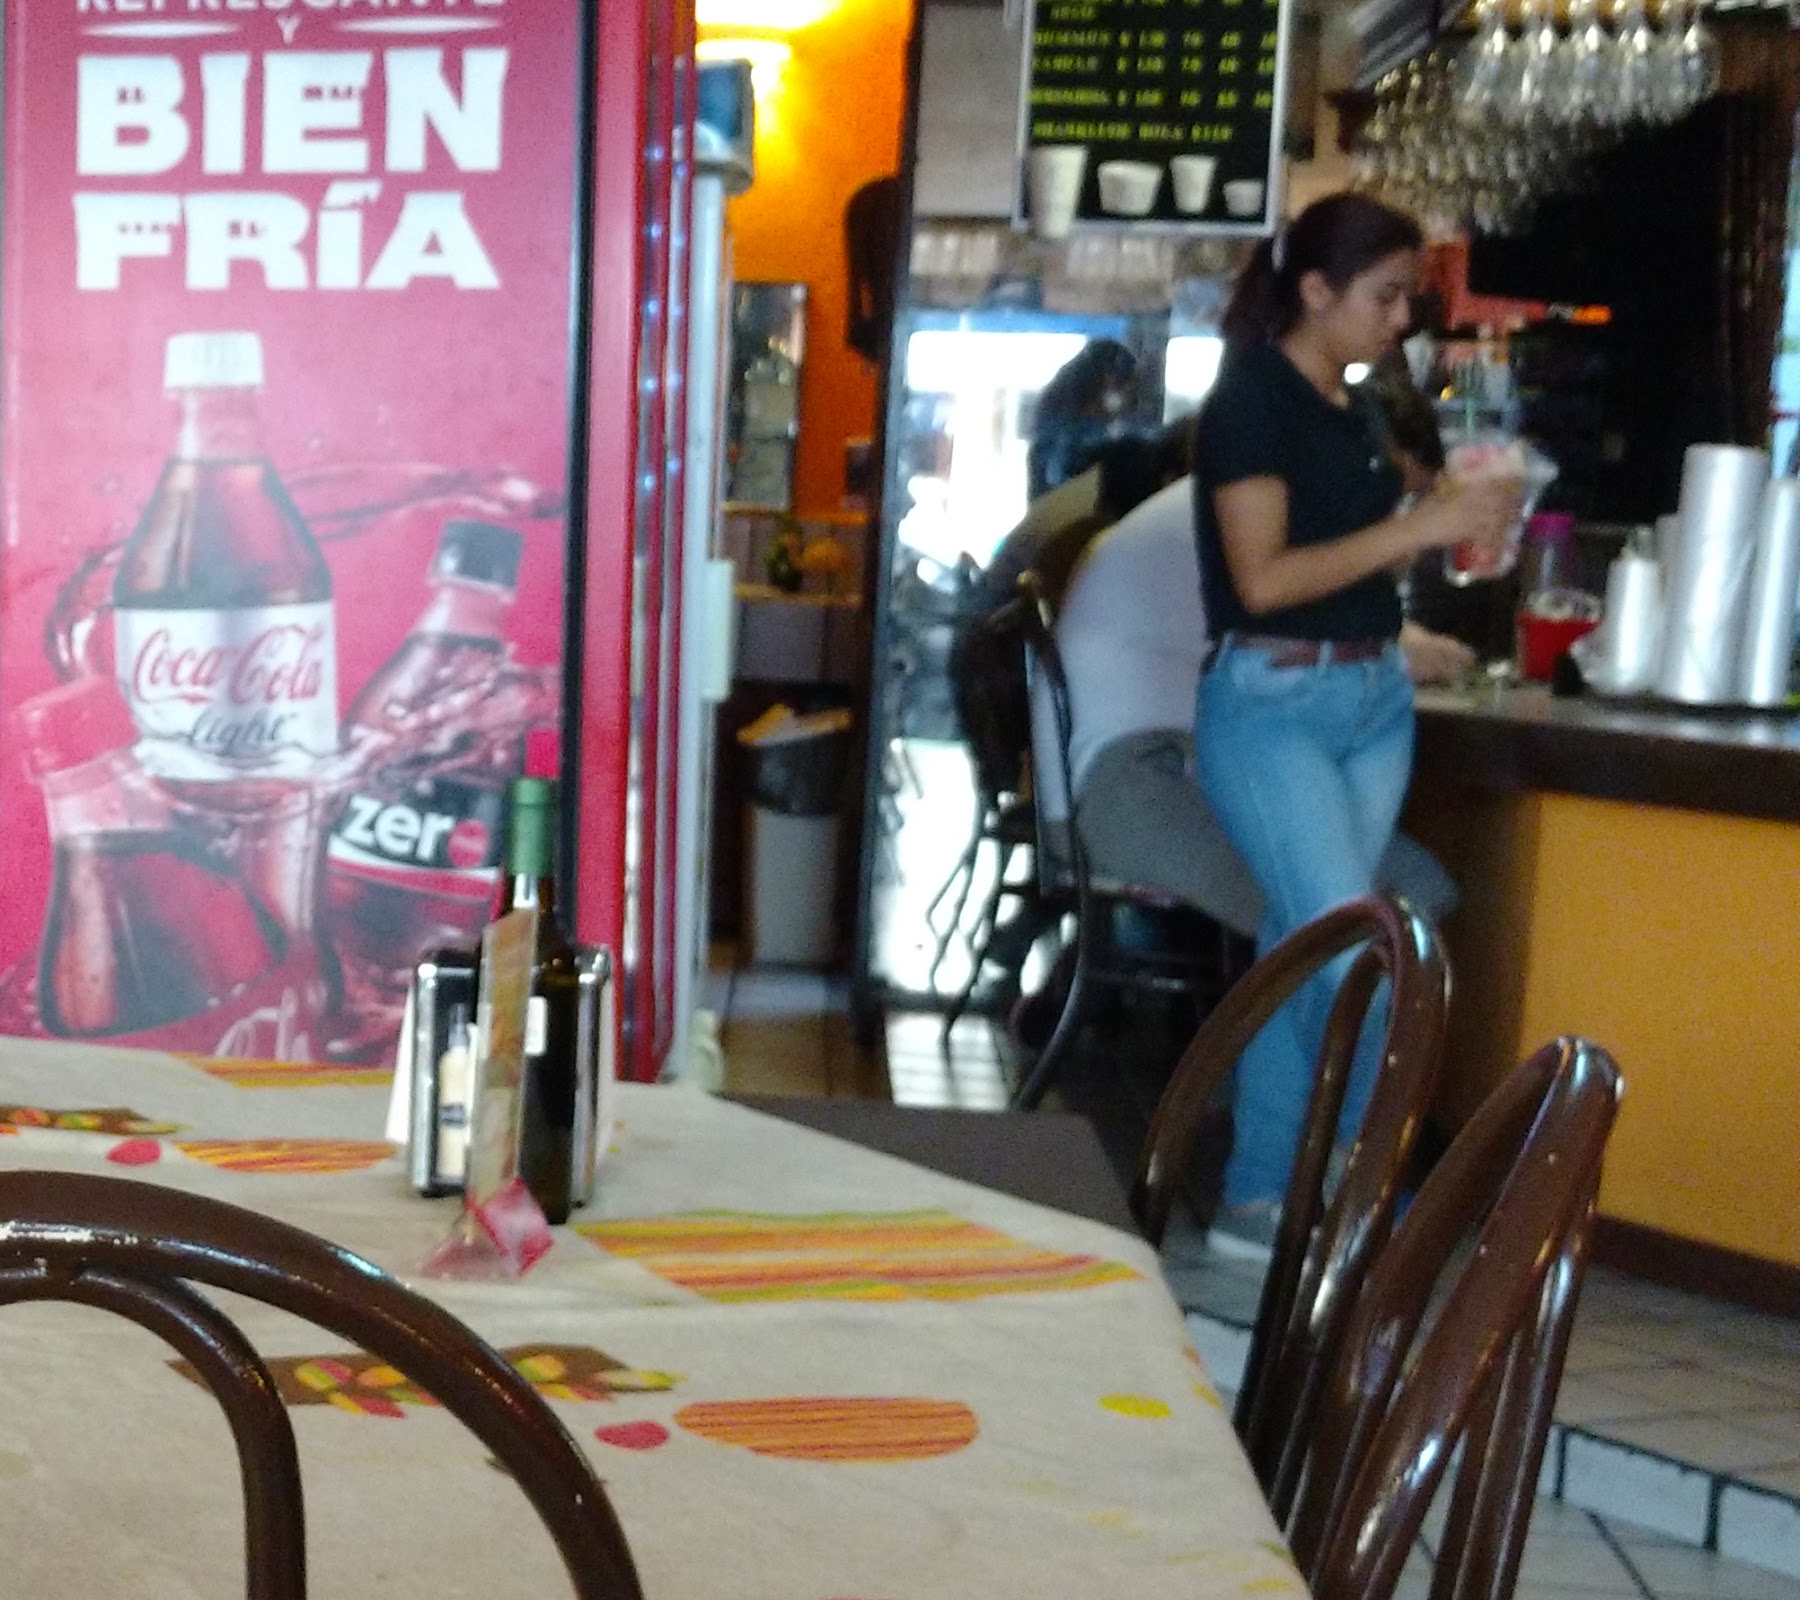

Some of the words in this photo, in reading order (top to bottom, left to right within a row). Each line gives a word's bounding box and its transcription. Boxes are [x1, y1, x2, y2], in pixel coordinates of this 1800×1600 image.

[276, 14, 300, 44] Y
[76, 47, 510, 175] BIEN
[71, 180, 501, 290] FRÍA
